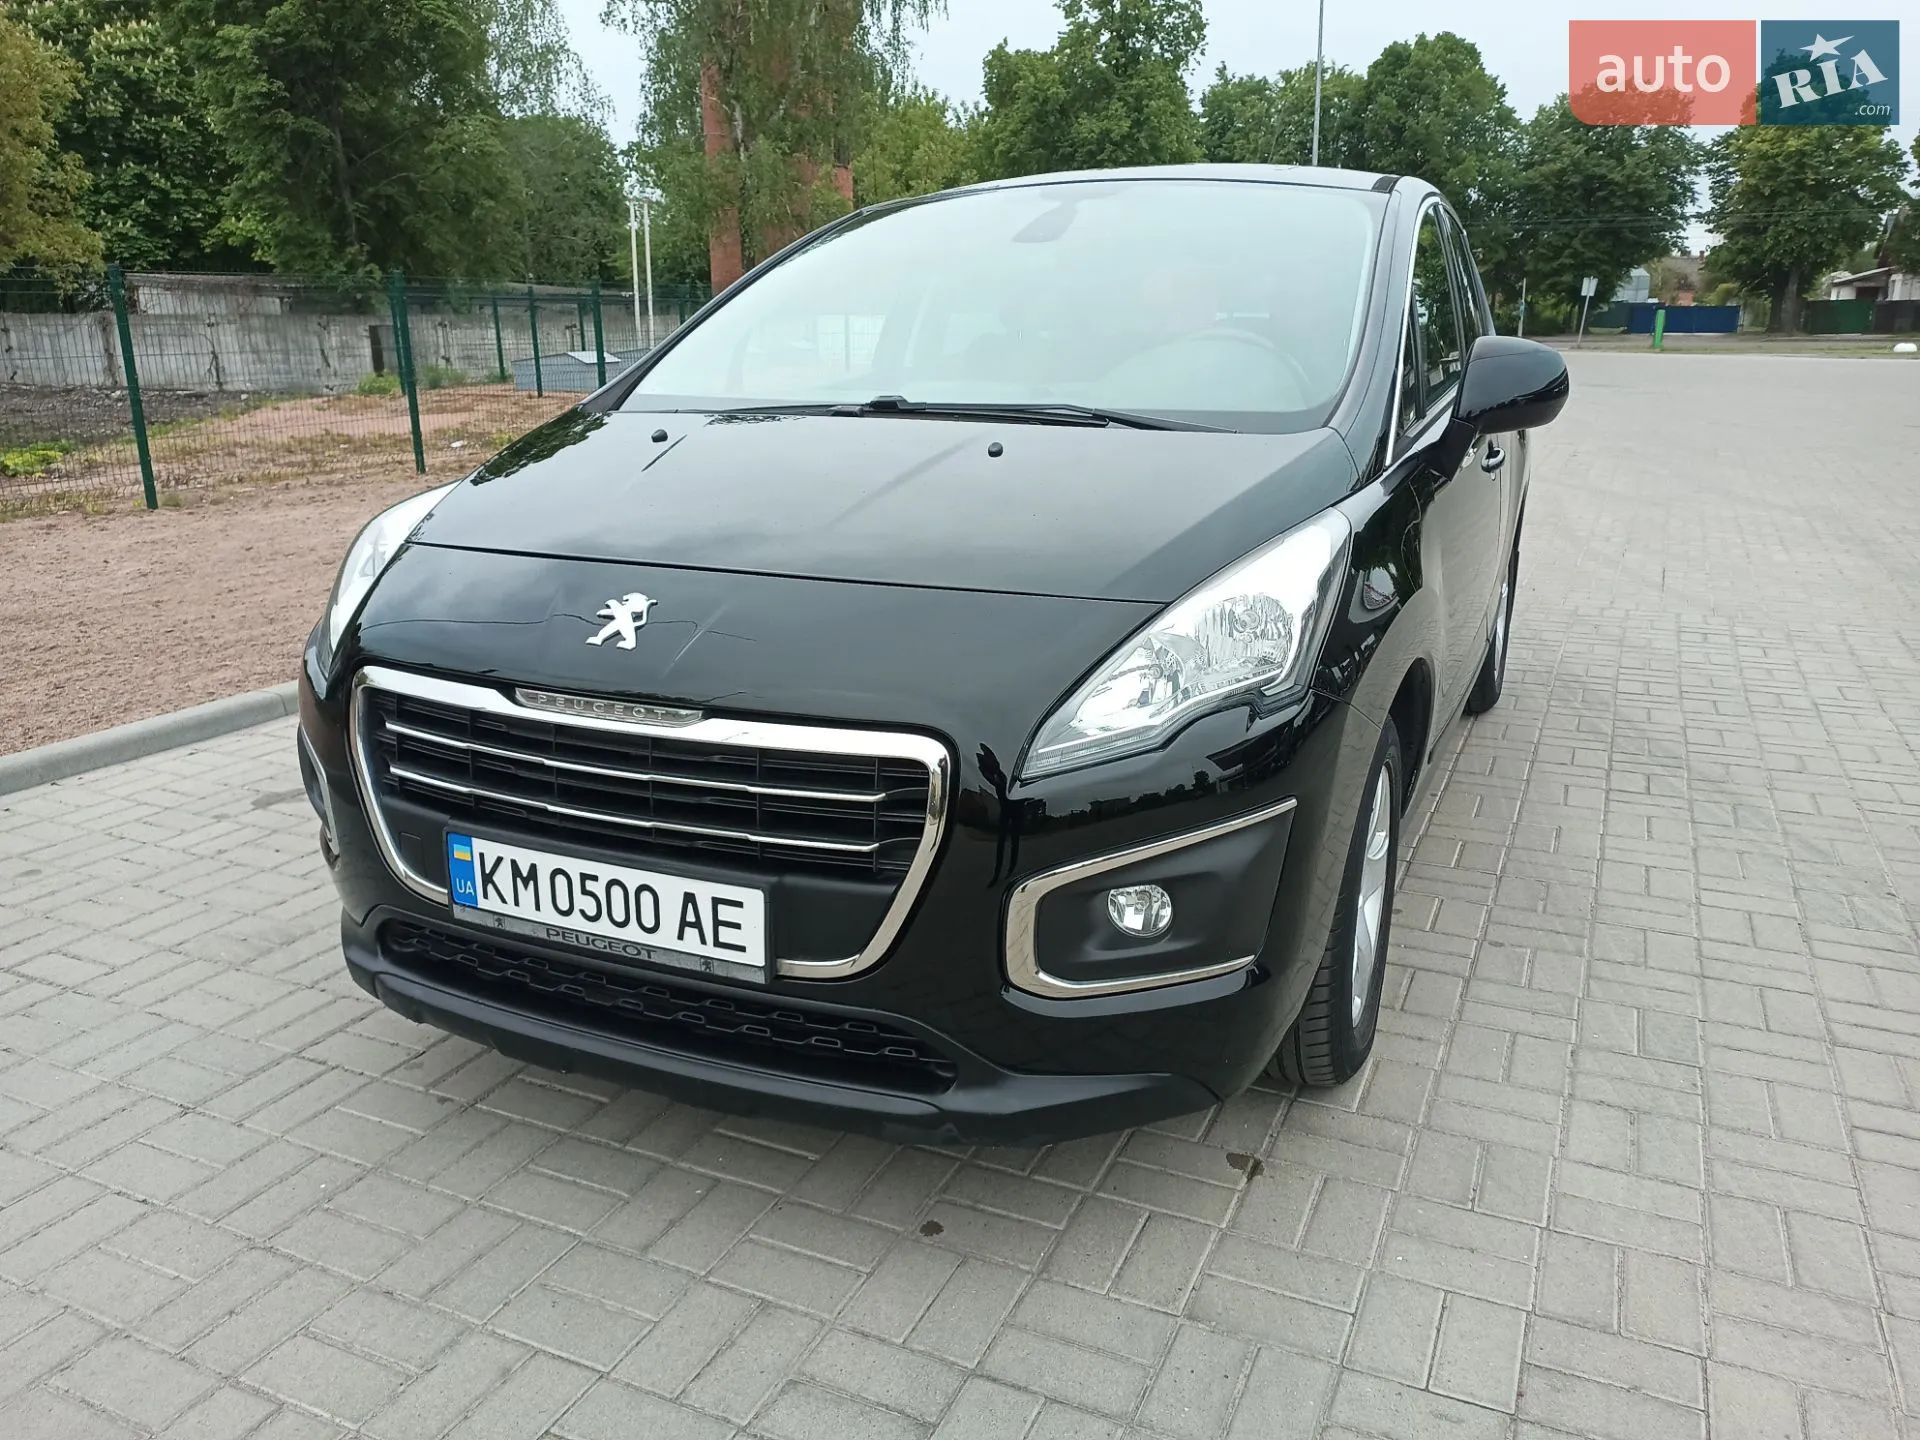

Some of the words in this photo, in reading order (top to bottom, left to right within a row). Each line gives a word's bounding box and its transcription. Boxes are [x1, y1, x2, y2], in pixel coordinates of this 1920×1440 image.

[537, 694, 667, 720] PEUGEOT
[456, 877, 475, 896] UA
[676, 891, 747, 953] AE
[545, 927, 657, 960] PEUGEOT
